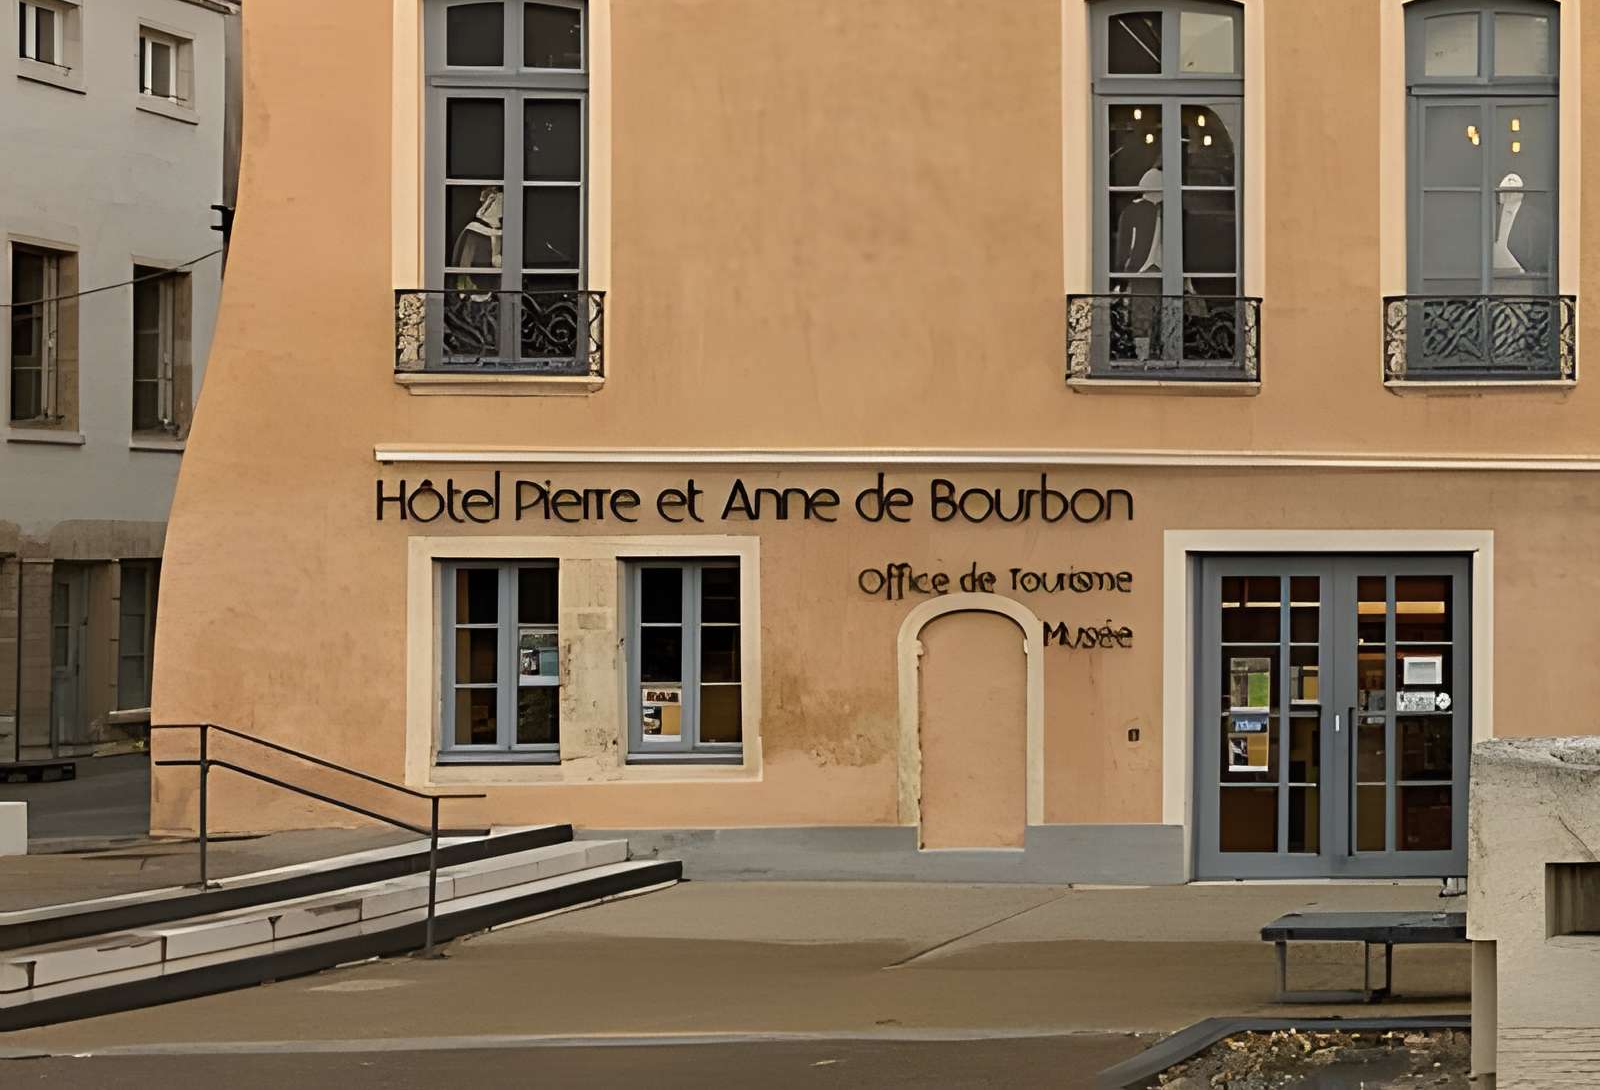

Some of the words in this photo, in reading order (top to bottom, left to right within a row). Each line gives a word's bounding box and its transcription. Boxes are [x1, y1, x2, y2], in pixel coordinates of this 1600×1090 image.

[376, 470, 500, 523] Hôtel
[515, 479, 641, 523] Pierre
[656, 479, 704, 523] et
[721, 479, 840, 523] Anne
[856, 472, 914, 523] de
[931, 472, 1133, 523] Bourbon
[858, 563, 950, 600] Office
[959, 562, 997, 593] de
[1009, 566, 1133, 593] Tourisme
[1043, 619, 1133, 649] Musée
